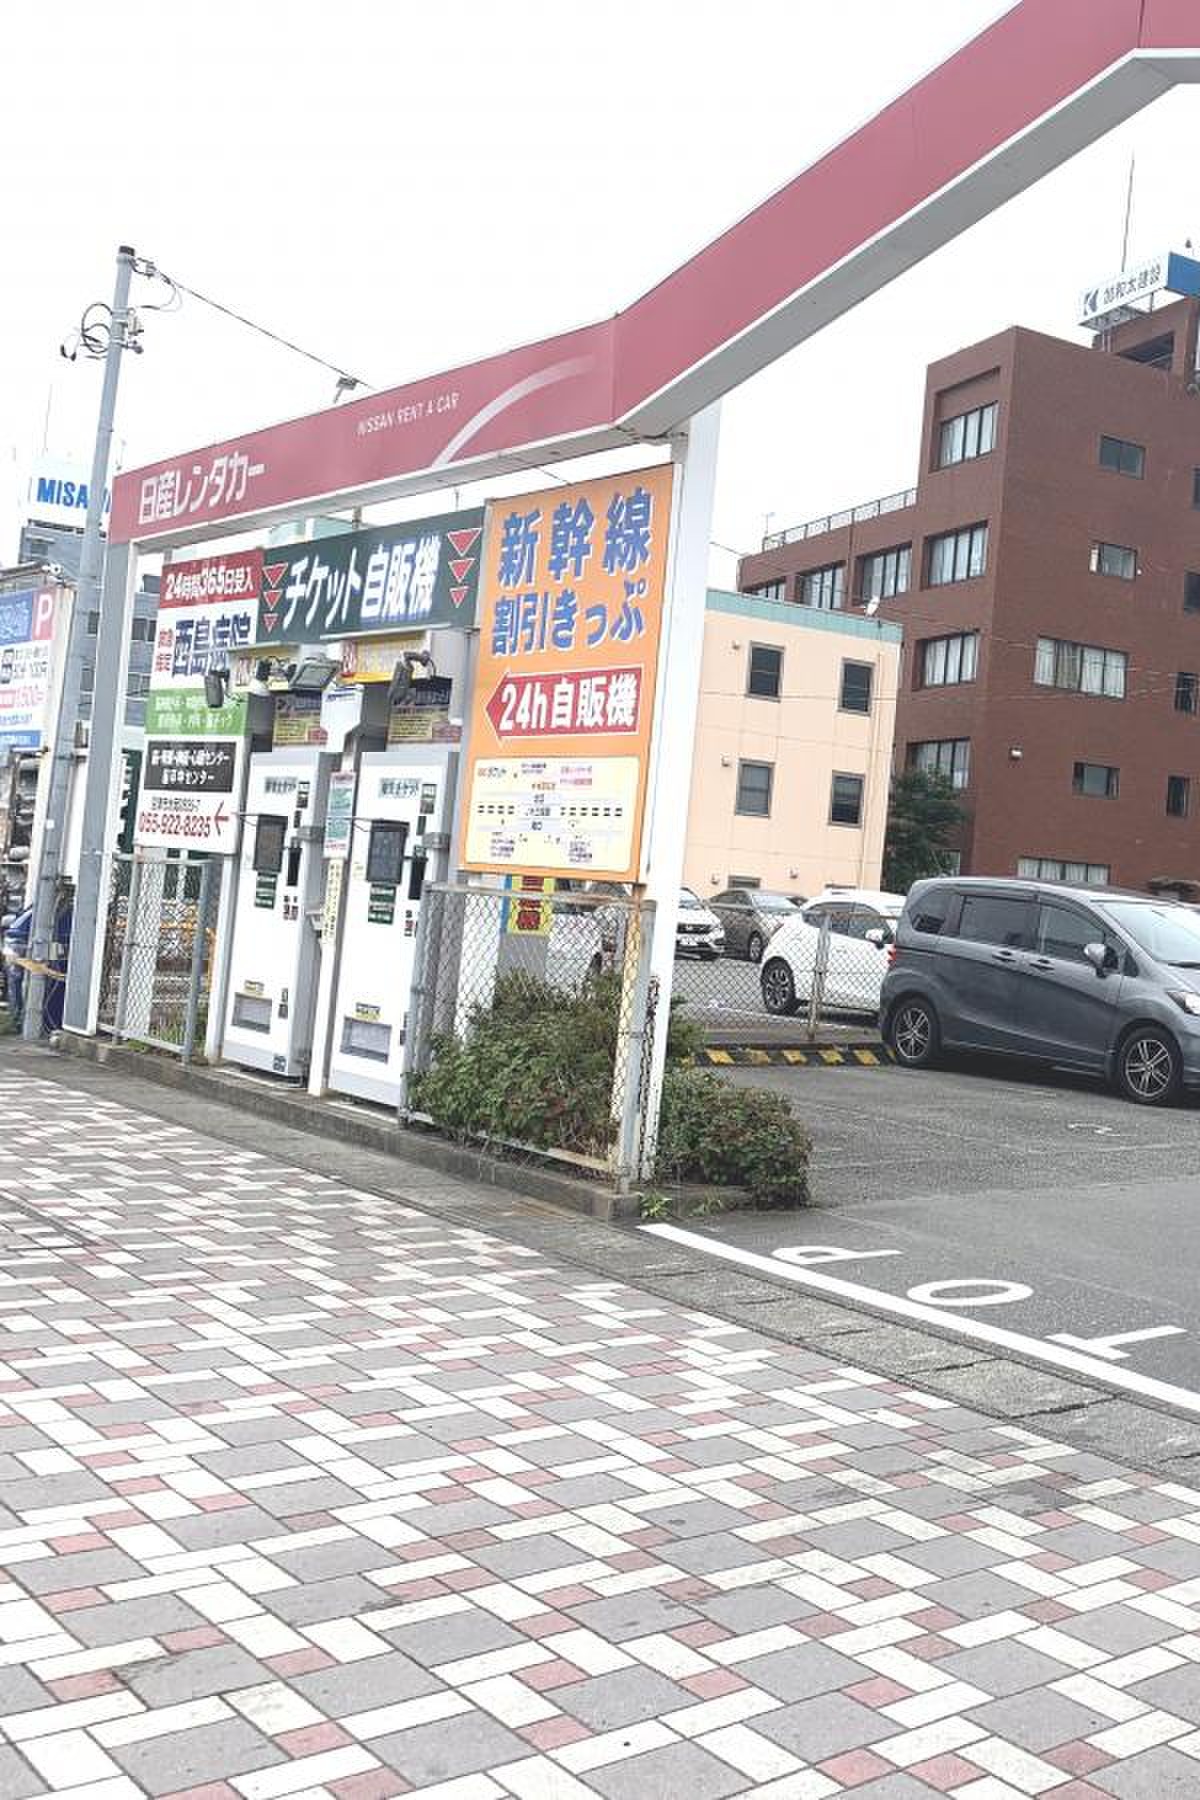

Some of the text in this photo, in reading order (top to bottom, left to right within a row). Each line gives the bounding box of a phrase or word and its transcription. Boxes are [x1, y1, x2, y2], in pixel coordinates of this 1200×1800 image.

[139, 451, 265, 525] 日産レンタカー
[498, 486, 656, 590] 新幹線
[35, 593, 52, 637] P
[281, 531, 442, 631] チケット自販機
[491, 577, 648, 658] 割引きっぷ
[499, 672, 638, 732] 24h自販機
